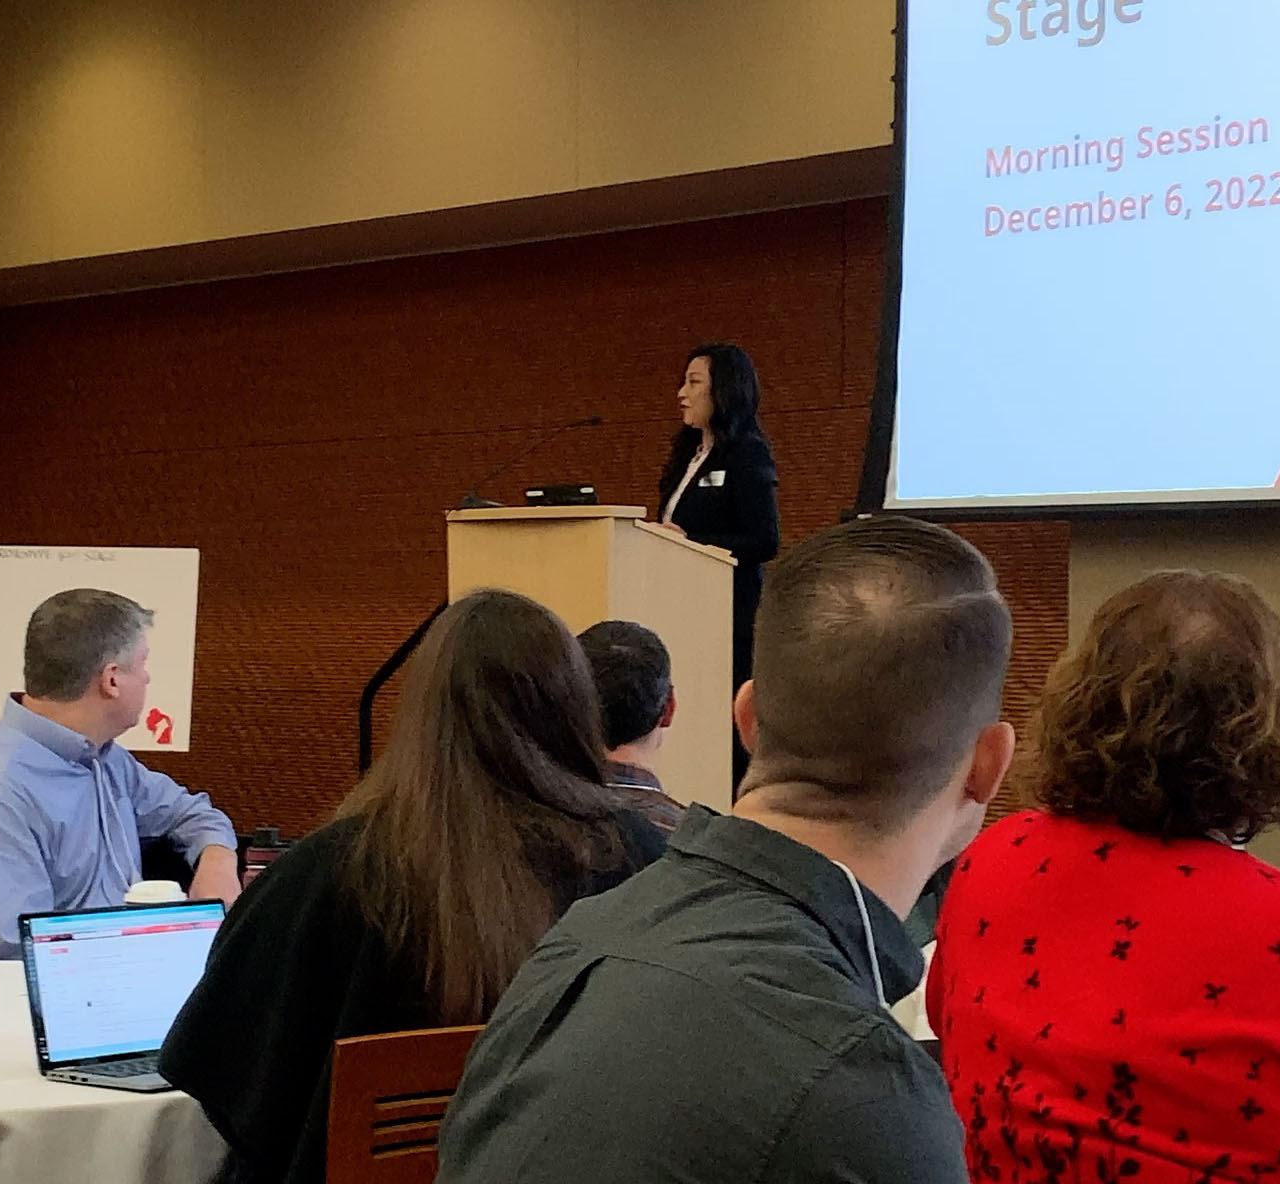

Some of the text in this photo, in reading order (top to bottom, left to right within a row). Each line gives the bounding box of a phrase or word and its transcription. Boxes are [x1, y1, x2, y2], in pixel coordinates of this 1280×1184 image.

[985, 0, 1143, 47] Stage
[985, 114, 1269, 178] Morning Session
[984, 190, 1154, 237] December
[1164, 183, 1192, 220] 6,
